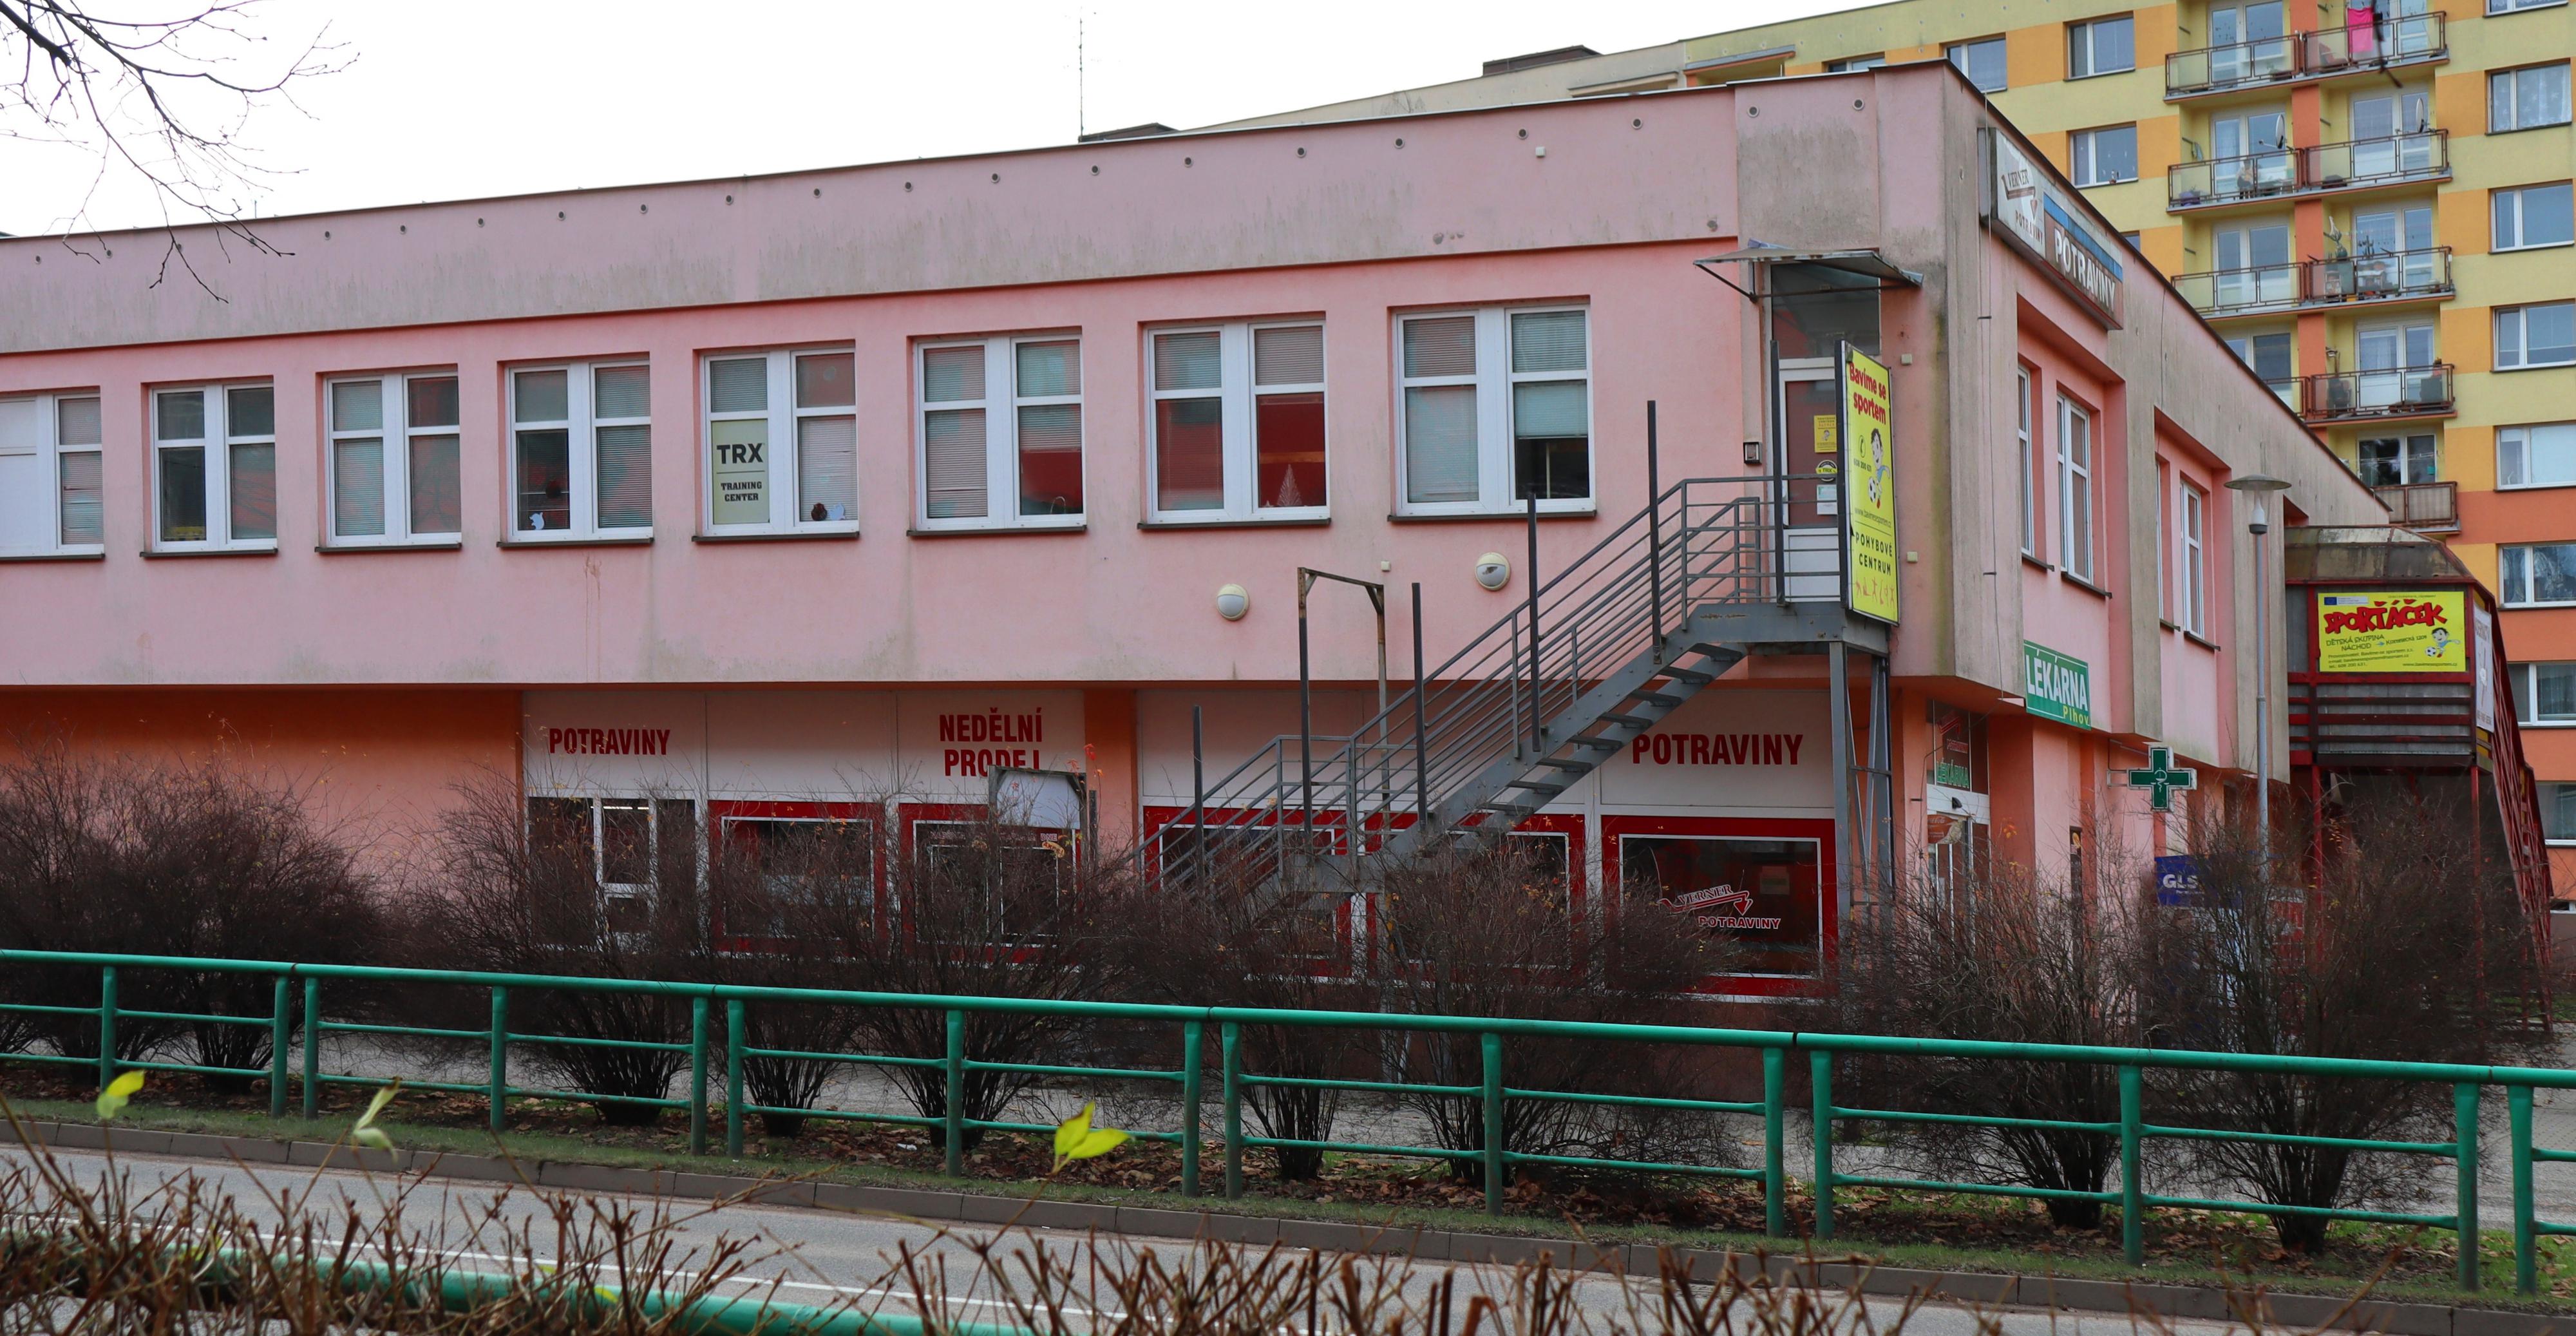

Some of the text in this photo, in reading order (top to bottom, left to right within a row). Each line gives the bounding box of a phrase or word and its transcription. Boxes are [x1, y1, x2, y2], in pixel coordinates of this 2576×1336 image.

[2008, 169, 2029, 189] VERNER
[2015, 209, 2043, 245] POTRAVINY
[2054, 227, 2116, 311] POTRAVINY
[1849, 361, 1886, 400] Bavíme se
[1853, 392, 1886, 425] sportem
[716, 443, 763, 464] TRX
[721, 481, 762, 490] TRAINING
[724, 493, 759, 502] CENTER
[1855, 531, 1893, 557] POHYBOVÉ
[1859, 553, 1891, 576] CENTRUM
[2324, 598, 2448, 634] SPORŤÁČEK
[2326, 634, 2385, 646] DĚTSKÁ SKUPINA
[2341, 643, 2372, 651] NÁCHOD
[939, 707, 1043, 743] NEDĚLNÍ
[2063, 705, 2090, 726] Plhov
[549, 728, 670, 755] POTRAVINY
[1633, 733, 1804, 765] POTRAVINY
[1041, 833, 1057, 841] DNE
[2163, 874, 2199, 889] GLS
[1678, 884, 1732, 906] VERNER
[1697, 915, 1781, 930] POTRAVINY
